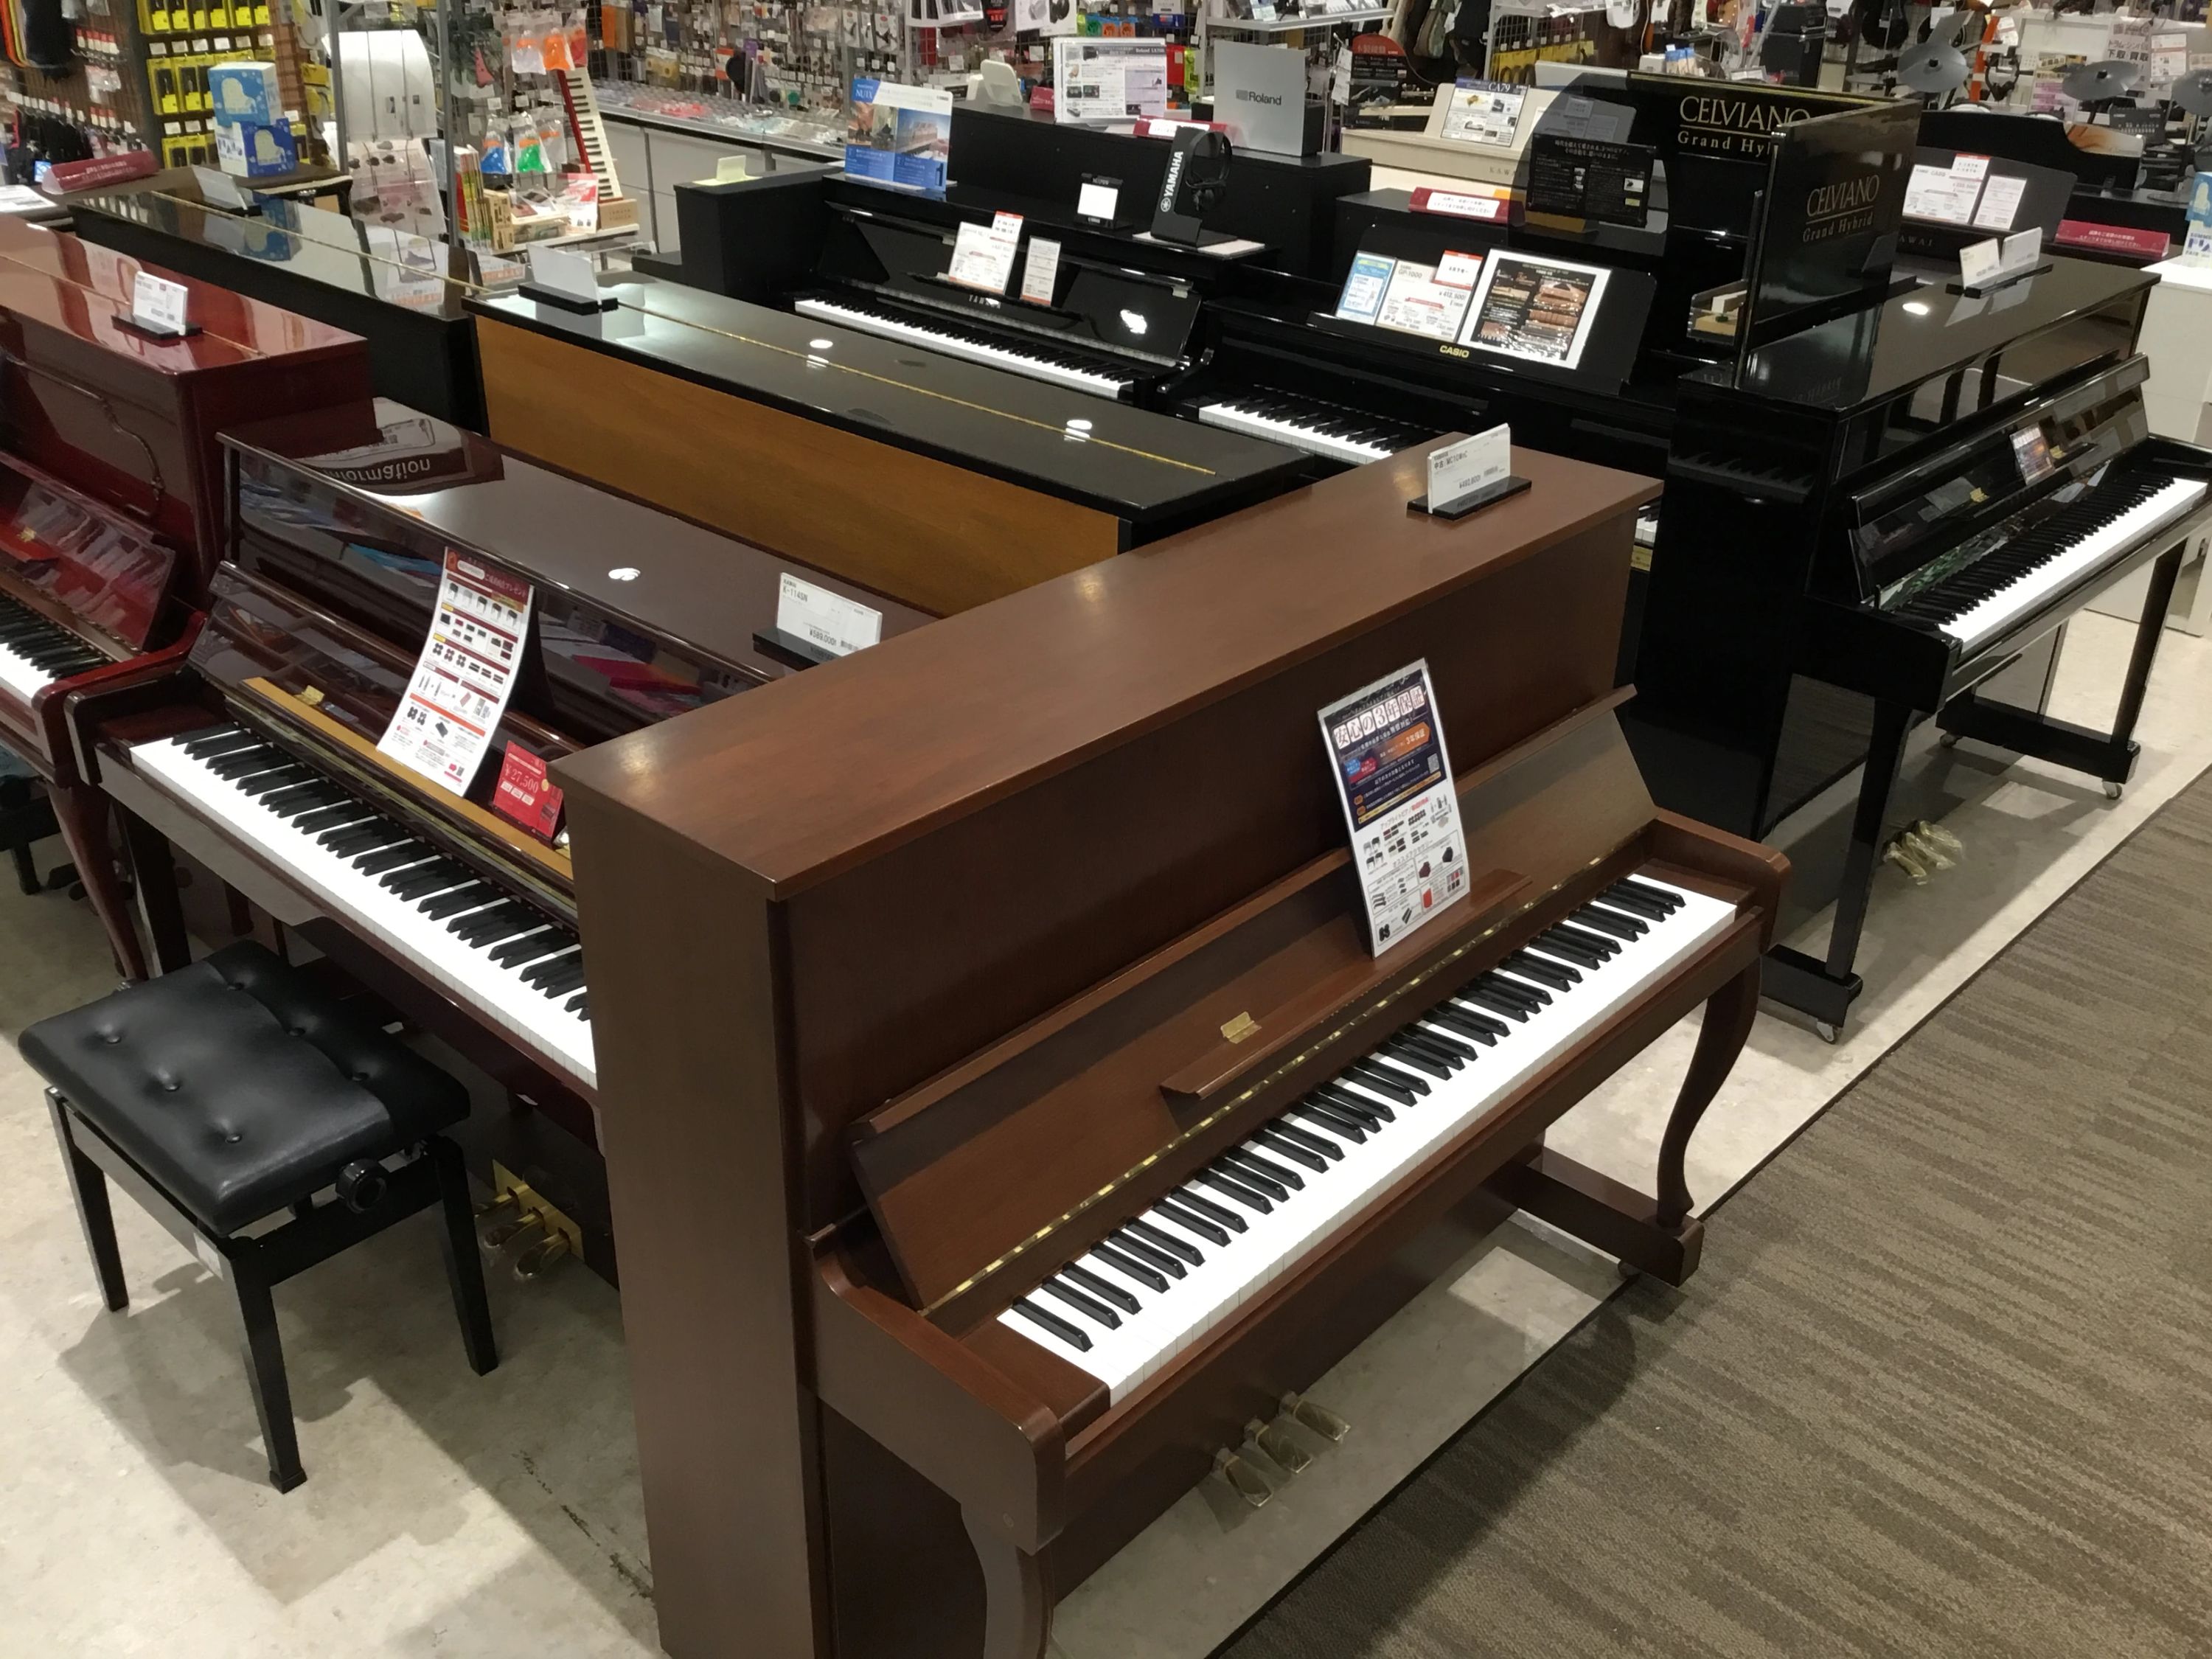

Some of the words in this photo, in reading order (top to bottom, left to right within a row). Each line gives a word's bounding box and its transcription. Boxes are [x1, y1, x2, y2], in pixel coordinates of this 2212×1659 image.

[1488, 82, 1511, 93] CA79
[1248, 91, 1281, 105] Roland
[1677, 131, 1731, 150] Grand
[1164, 151, 1184, 197] YAMAHA
[1806, 174, 1880, 218] CELVIANO
[1802, 221, 1834, 243] Grand
[1837, 211, 1874, 235] Hybrid
[1899, 234, 1933, 247] AWAI
[968, 294, 1001, 309] YAMA
[1439, 345, 1470, 358] CASIO
[1333, 686, 1425, 750] 安心の3年保証
[505, 763, 539, 793] ¥27,500
